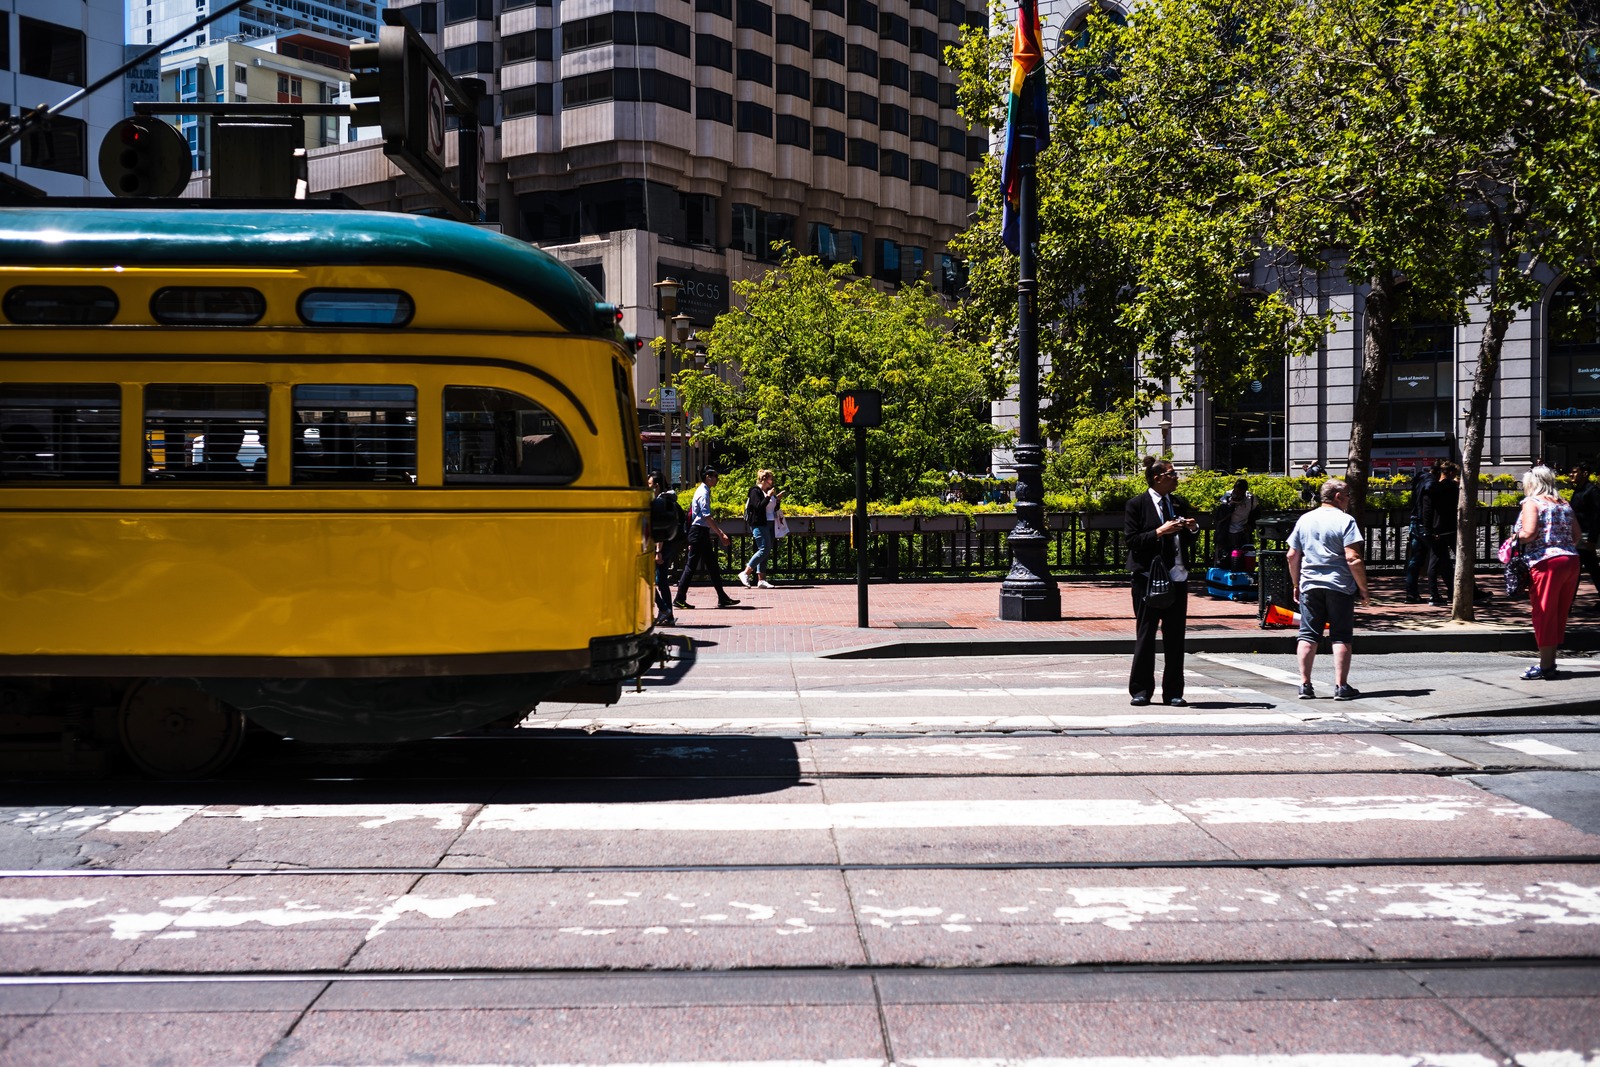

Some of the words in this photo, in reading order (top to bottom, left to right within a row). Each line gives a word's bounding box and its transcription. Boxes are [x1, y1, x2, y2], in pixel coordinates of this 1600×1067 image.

[126, 69, 158, 79] HALLIDIE
[130, 83, 154, 93] PLAZA
[669, 277, 705, 298] ARC
[706, 283, 720, 300] 55
[1541, 407, 1561, 417] Bank
[1562, 407, 1571, 416] of
